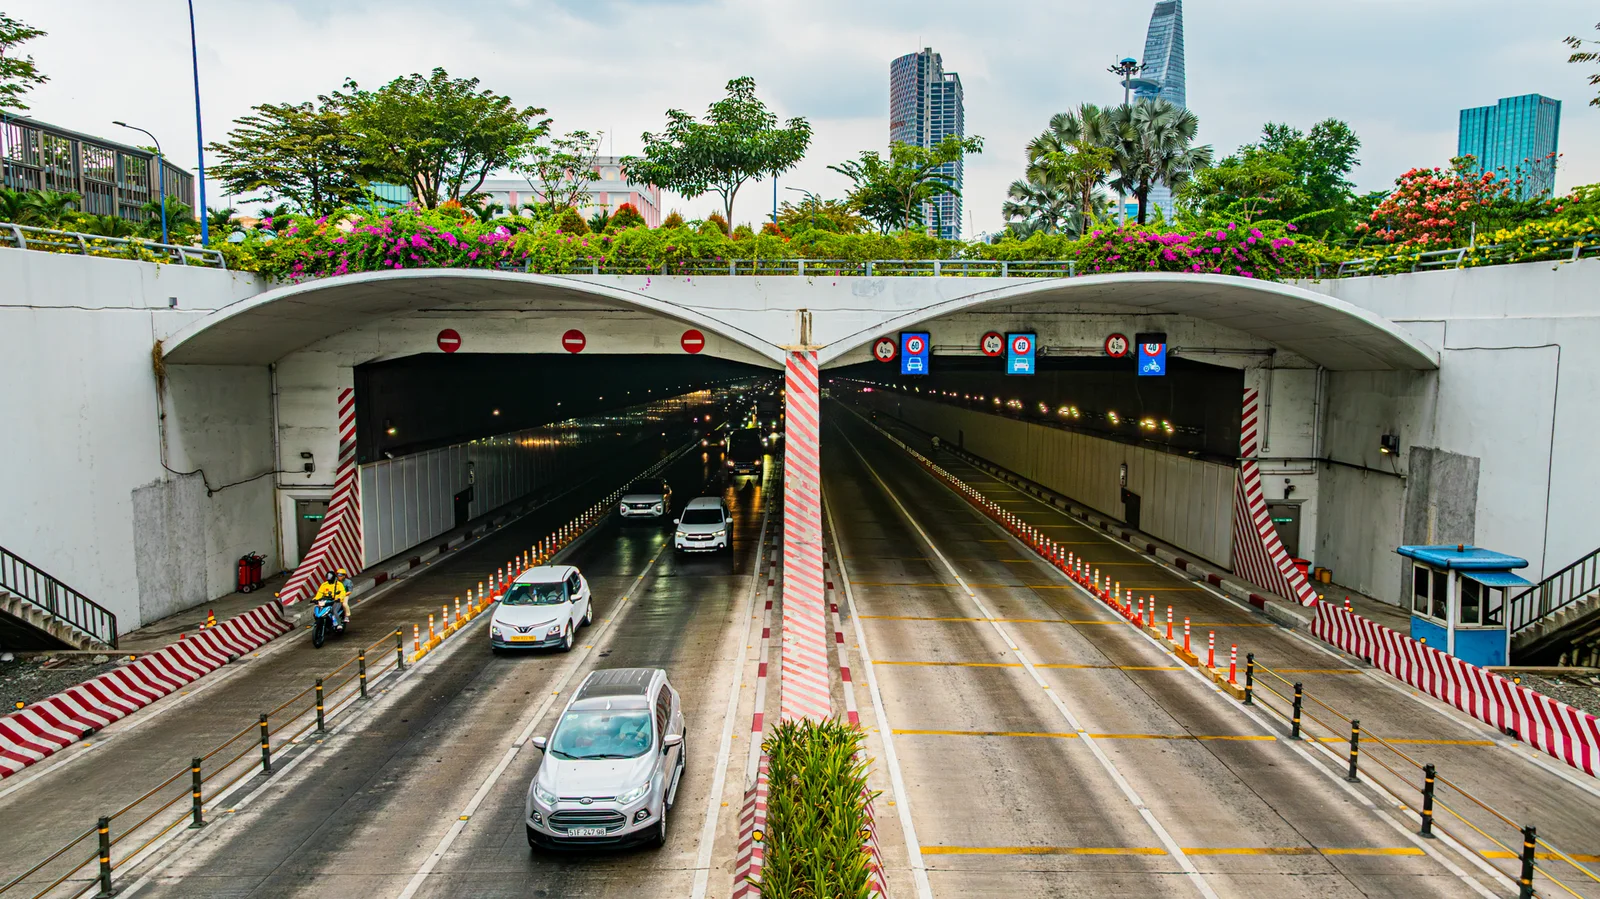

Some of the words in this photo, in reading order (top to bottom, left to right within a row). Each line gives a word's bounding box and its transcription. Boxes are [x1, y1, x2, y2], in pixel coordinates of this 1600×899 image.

[911, 341, 920, 350] 60
[1017, 341, 1026, 350] 60
[1148, 343, 1157, 351] 40
